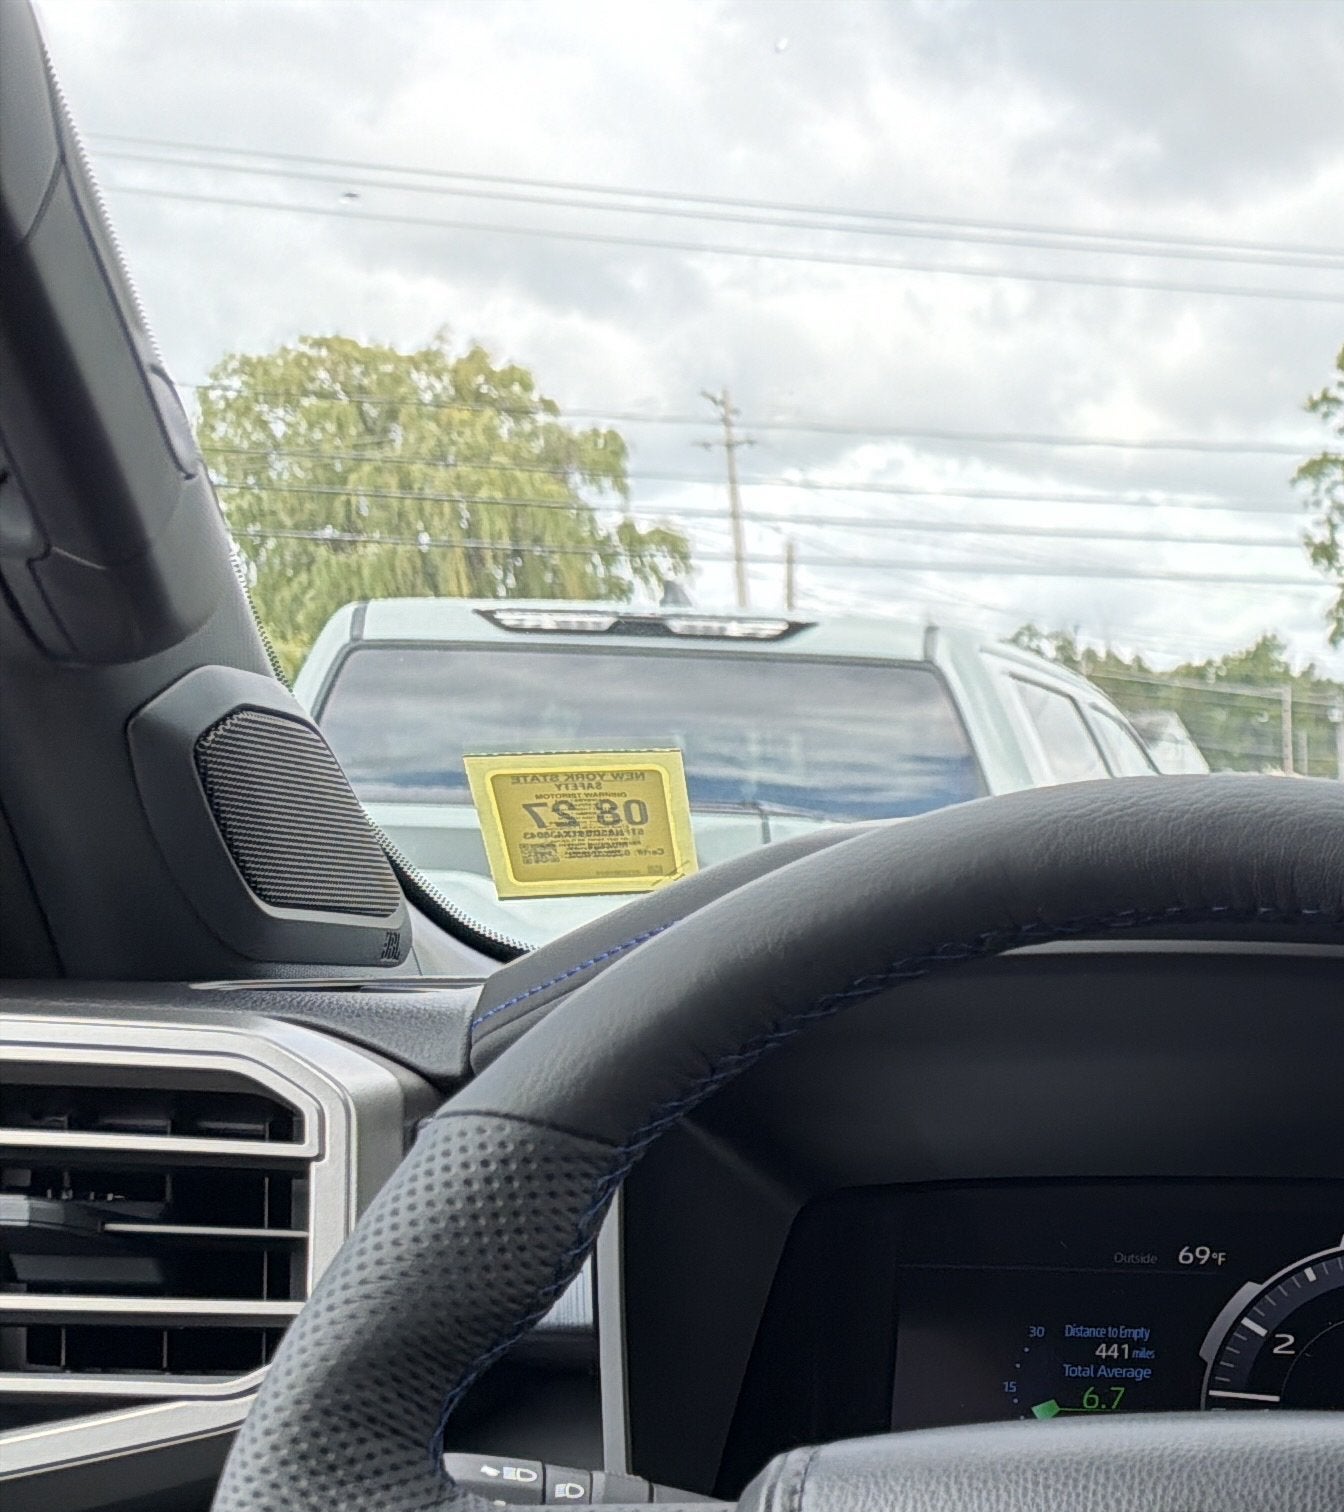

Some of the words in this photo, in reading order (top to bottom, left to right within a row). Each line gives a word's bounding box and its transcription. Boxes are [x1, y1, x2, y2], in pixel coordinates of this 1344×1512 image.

[1113, 1250, 1158, 1266] Outside
[1028, 1325, 1046, 1339] 30
[1064, 1323, 1104, 1340] Distance
[1105, 1325, 1118, 1340] to
[1119, 1324, 1151, 1344] Empty
[1094, 1342, 1131, 1361] 441
[1131, 1347, 1156, 1361] miles
[1271, 1333, 1297, 1356] 2
[1063, 1363, 1095, 1380] Total
[1096, 1364, 1153, 1383] Average
[1003, 1381, 1017, 1393] 15
[1082, 1386, 1126, 1411] 6.7
